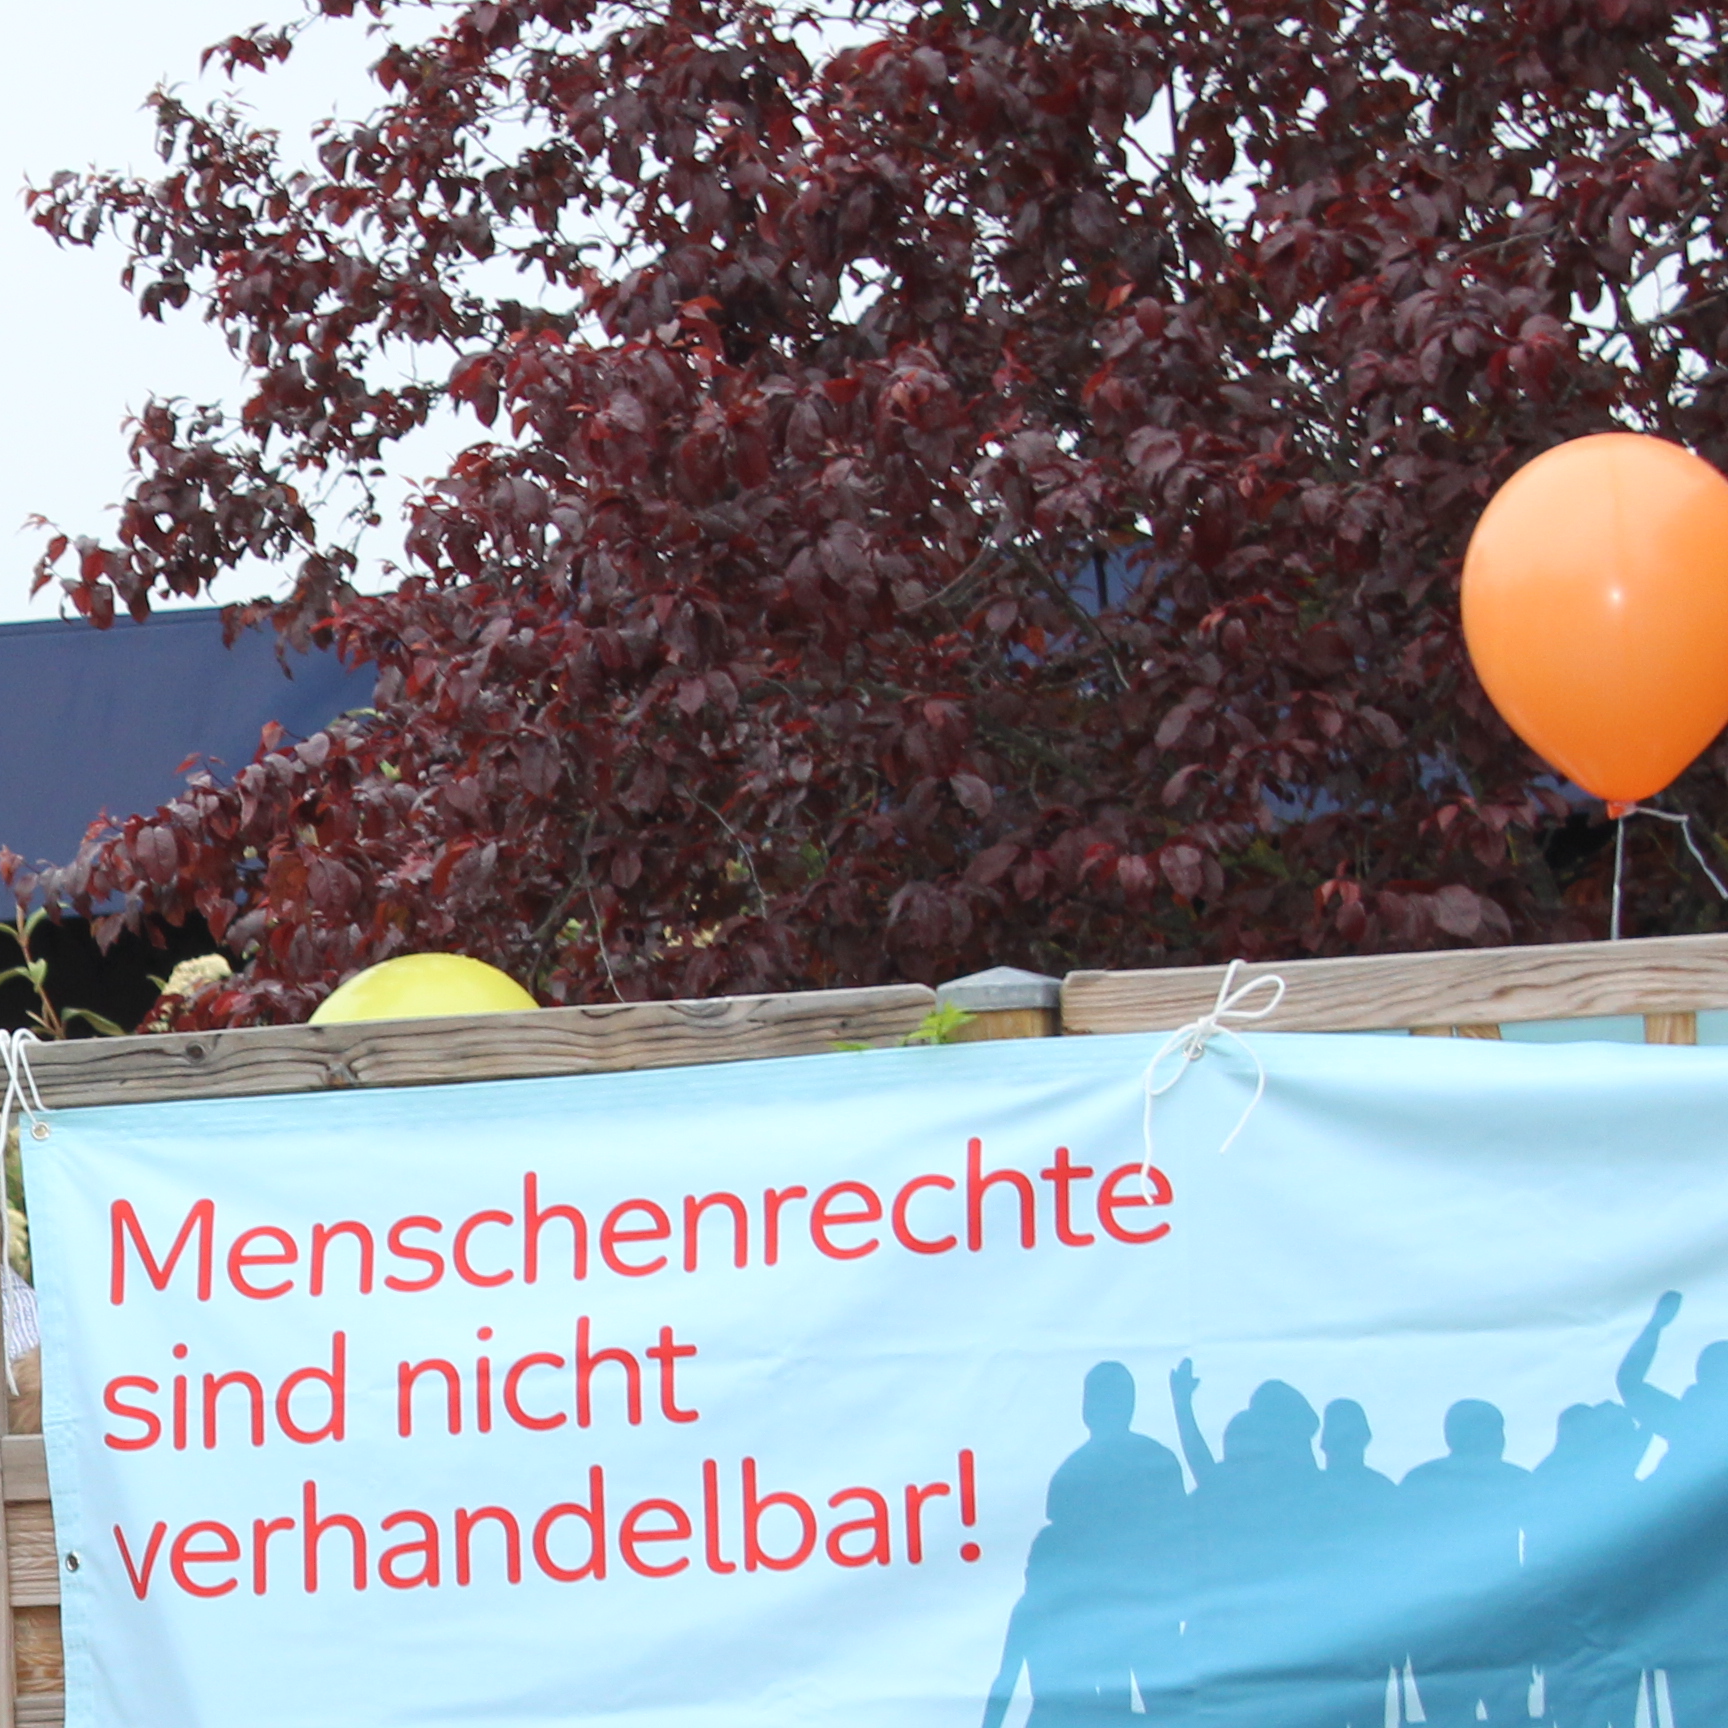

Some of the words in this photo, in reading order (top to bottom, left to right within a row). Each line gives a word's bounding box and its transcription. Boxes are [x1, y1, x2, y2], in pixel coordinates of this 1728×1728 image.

[110, 1137, 1173, 1305] Menschenrechte
[104, 1331, 346, 1451] sind
[399, 1317, 699, 1437] nicht
[115, 1449, 982, 1600] verhandelbar!
